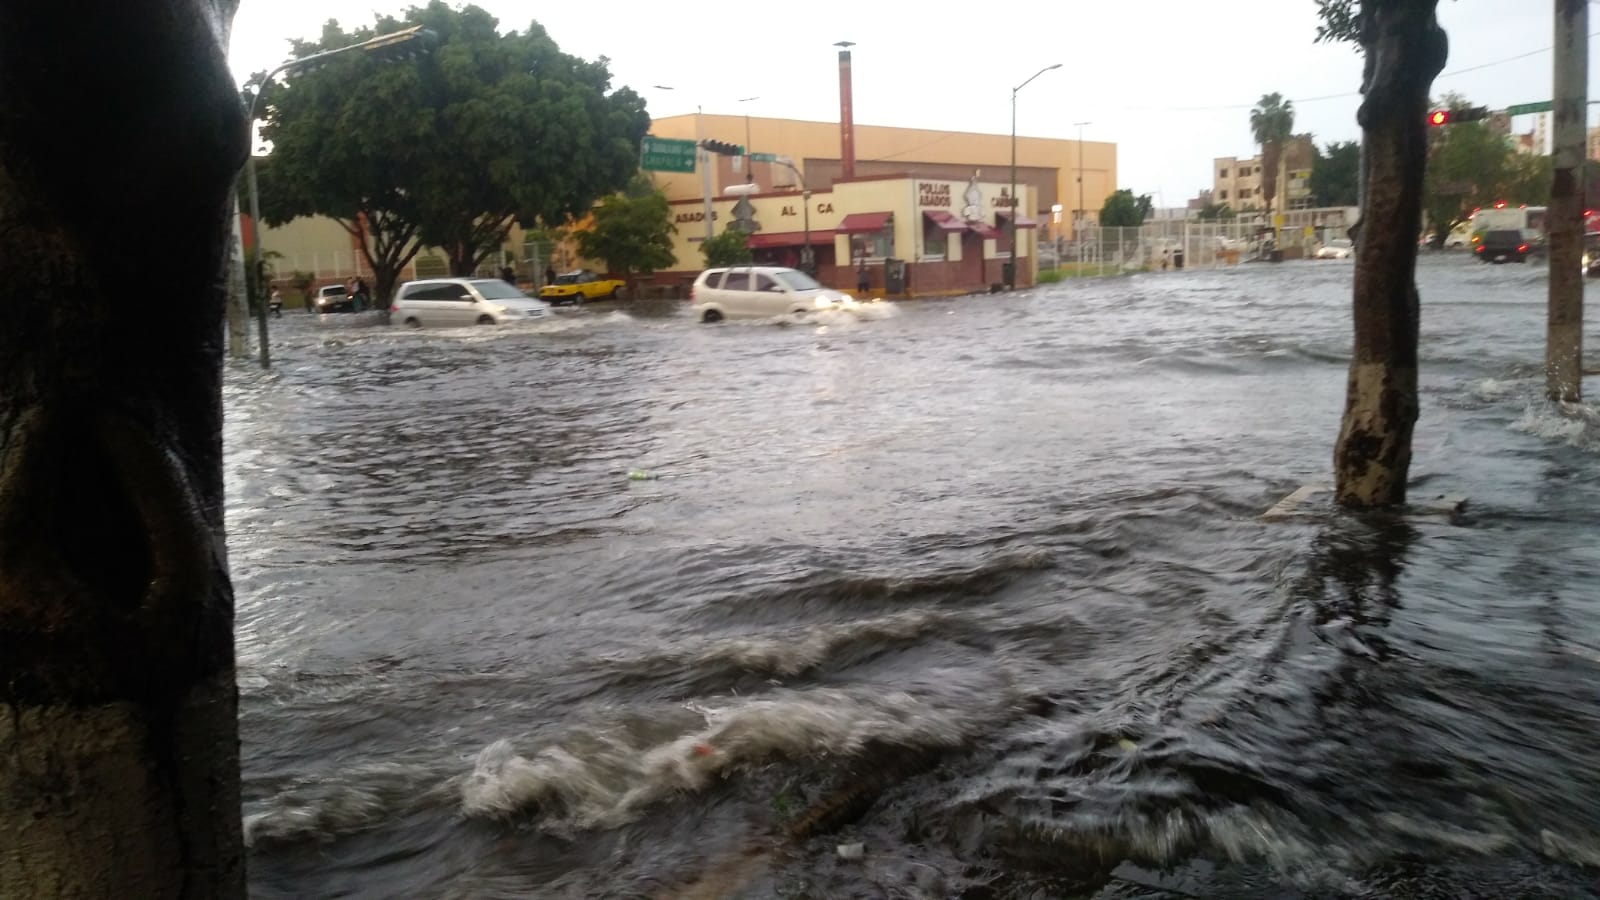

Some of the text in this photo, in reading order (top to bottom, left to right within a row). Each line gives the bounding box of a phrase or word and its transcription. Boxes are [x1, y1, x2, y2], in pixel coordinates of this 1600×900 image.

[675, 203, 834, 223] ASADS AL CA
